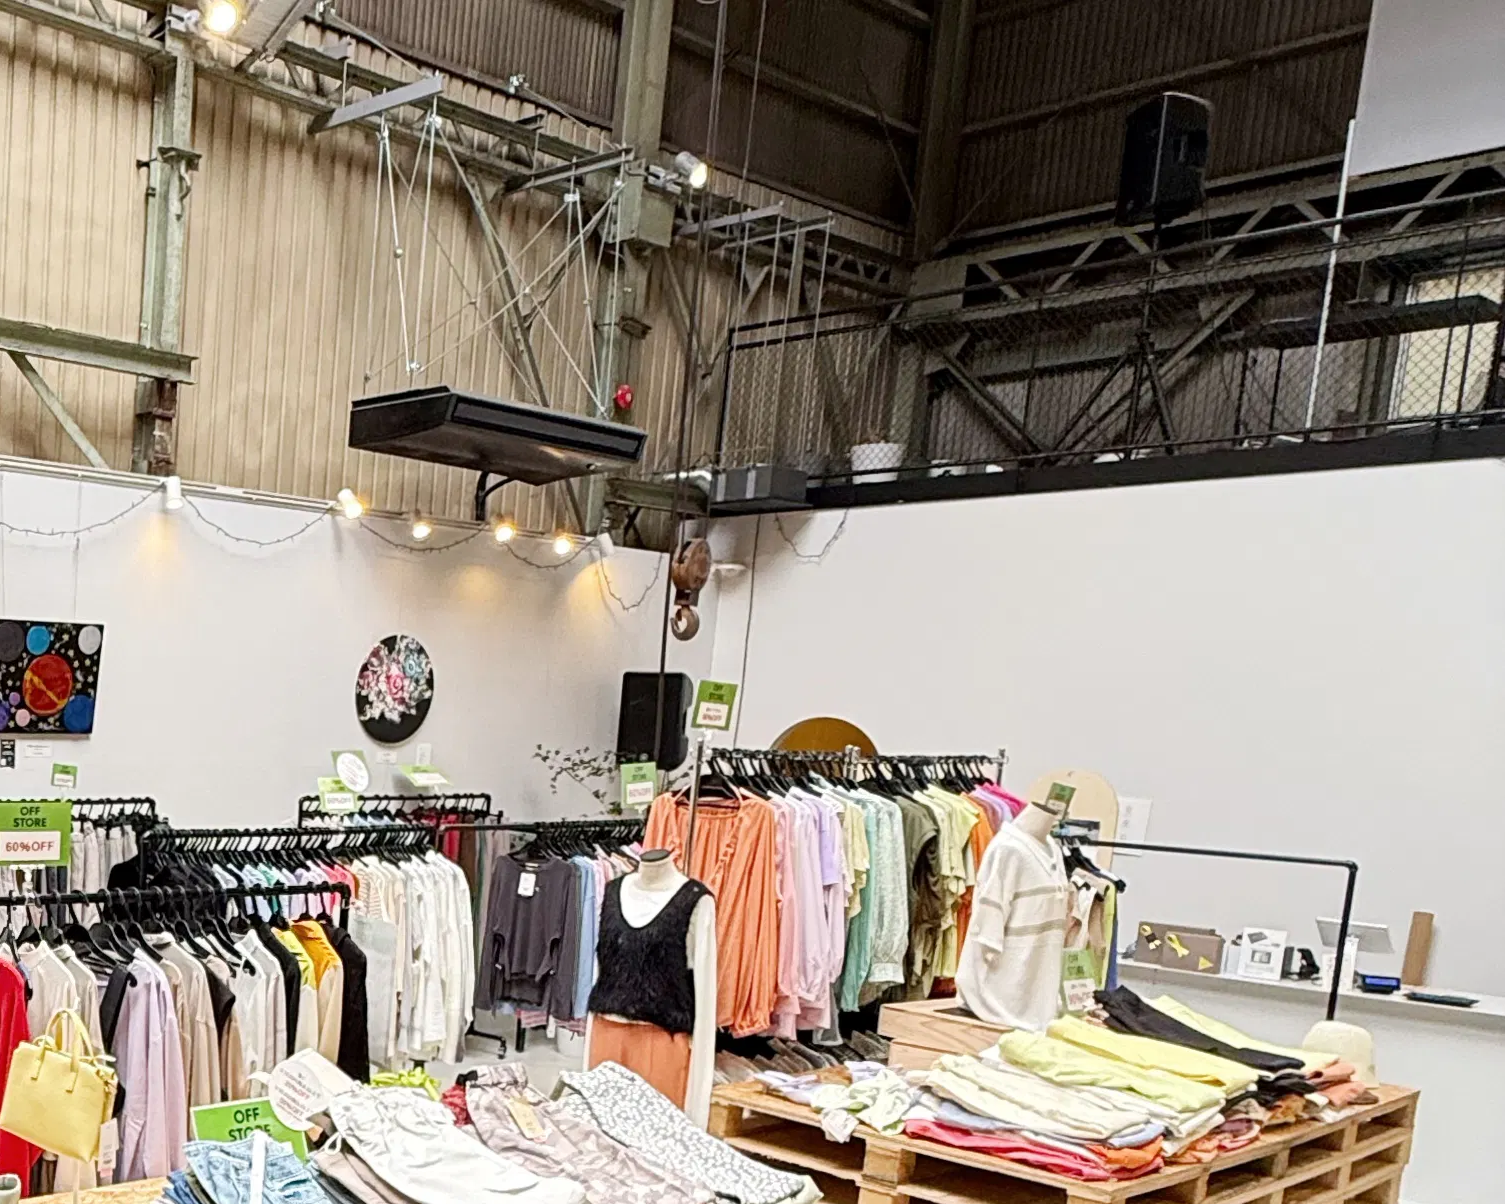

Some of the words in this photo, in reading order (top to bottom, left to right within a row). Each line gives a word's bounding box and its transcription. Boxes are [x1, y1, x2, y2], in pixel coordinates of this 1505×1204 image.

[20, 806, 41, 816] OFF
[13, 818, 47, 828] STORE
[5, 841, 55, 852] 60%OFF
[233, 1107, 260, 1124] OFF
